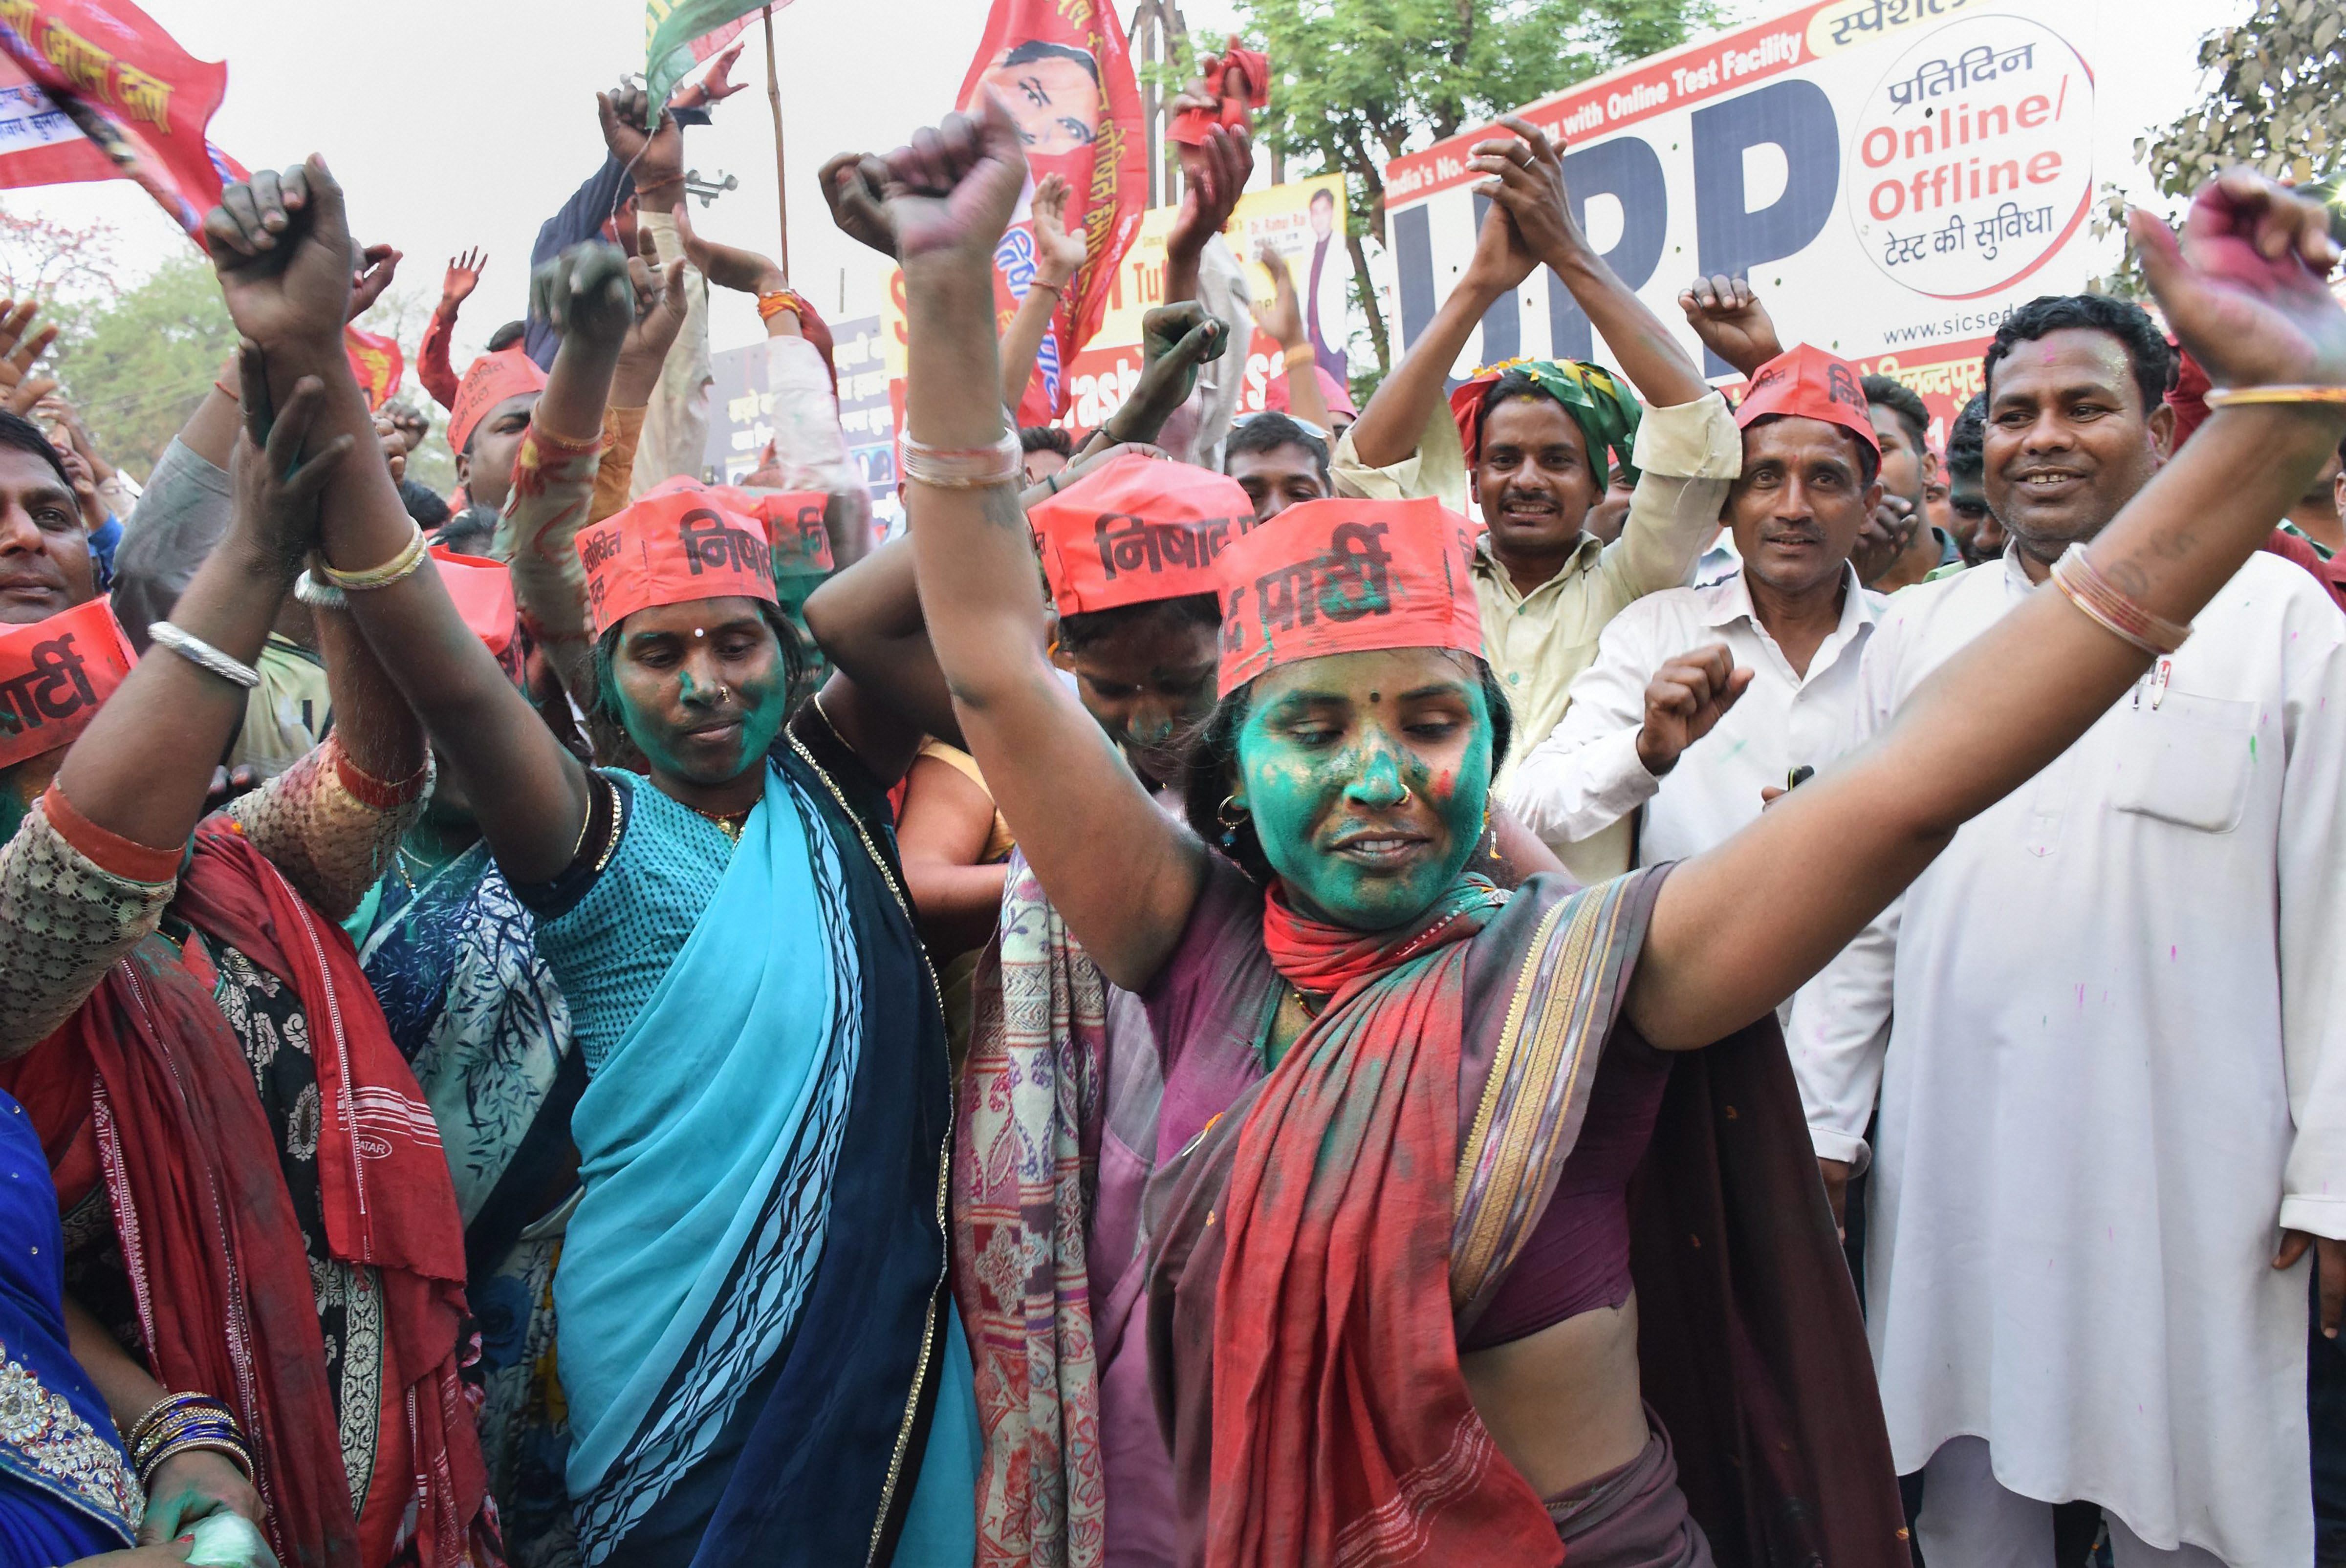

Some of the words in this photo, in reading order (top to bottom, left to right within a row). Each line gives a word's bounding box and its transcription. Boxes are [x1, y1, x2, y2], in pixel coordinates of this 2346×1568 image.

[1888, 43, 2036, 114] प्रतिदिन
[1385, 164, 1434, 199] India's
[1436, 155, 1463, 182] No.
[1563, 101, 1604, 136] with
[1607, 81, 1669, 120] Online
[1672, 58, 1718, 97] Test
[1721, 32, 1802, 80] Facility
[1869, 150, 2062, 221] Offline
[1884, 230, 1926, 266] टेस्ट
[1933, 215, 1965, 253] की
[1974, 202, 2054, 260] सुविधा
[1884, 303, 2014, 344] www.sicsed
[360, 1140, 385, 1154] ATAR
